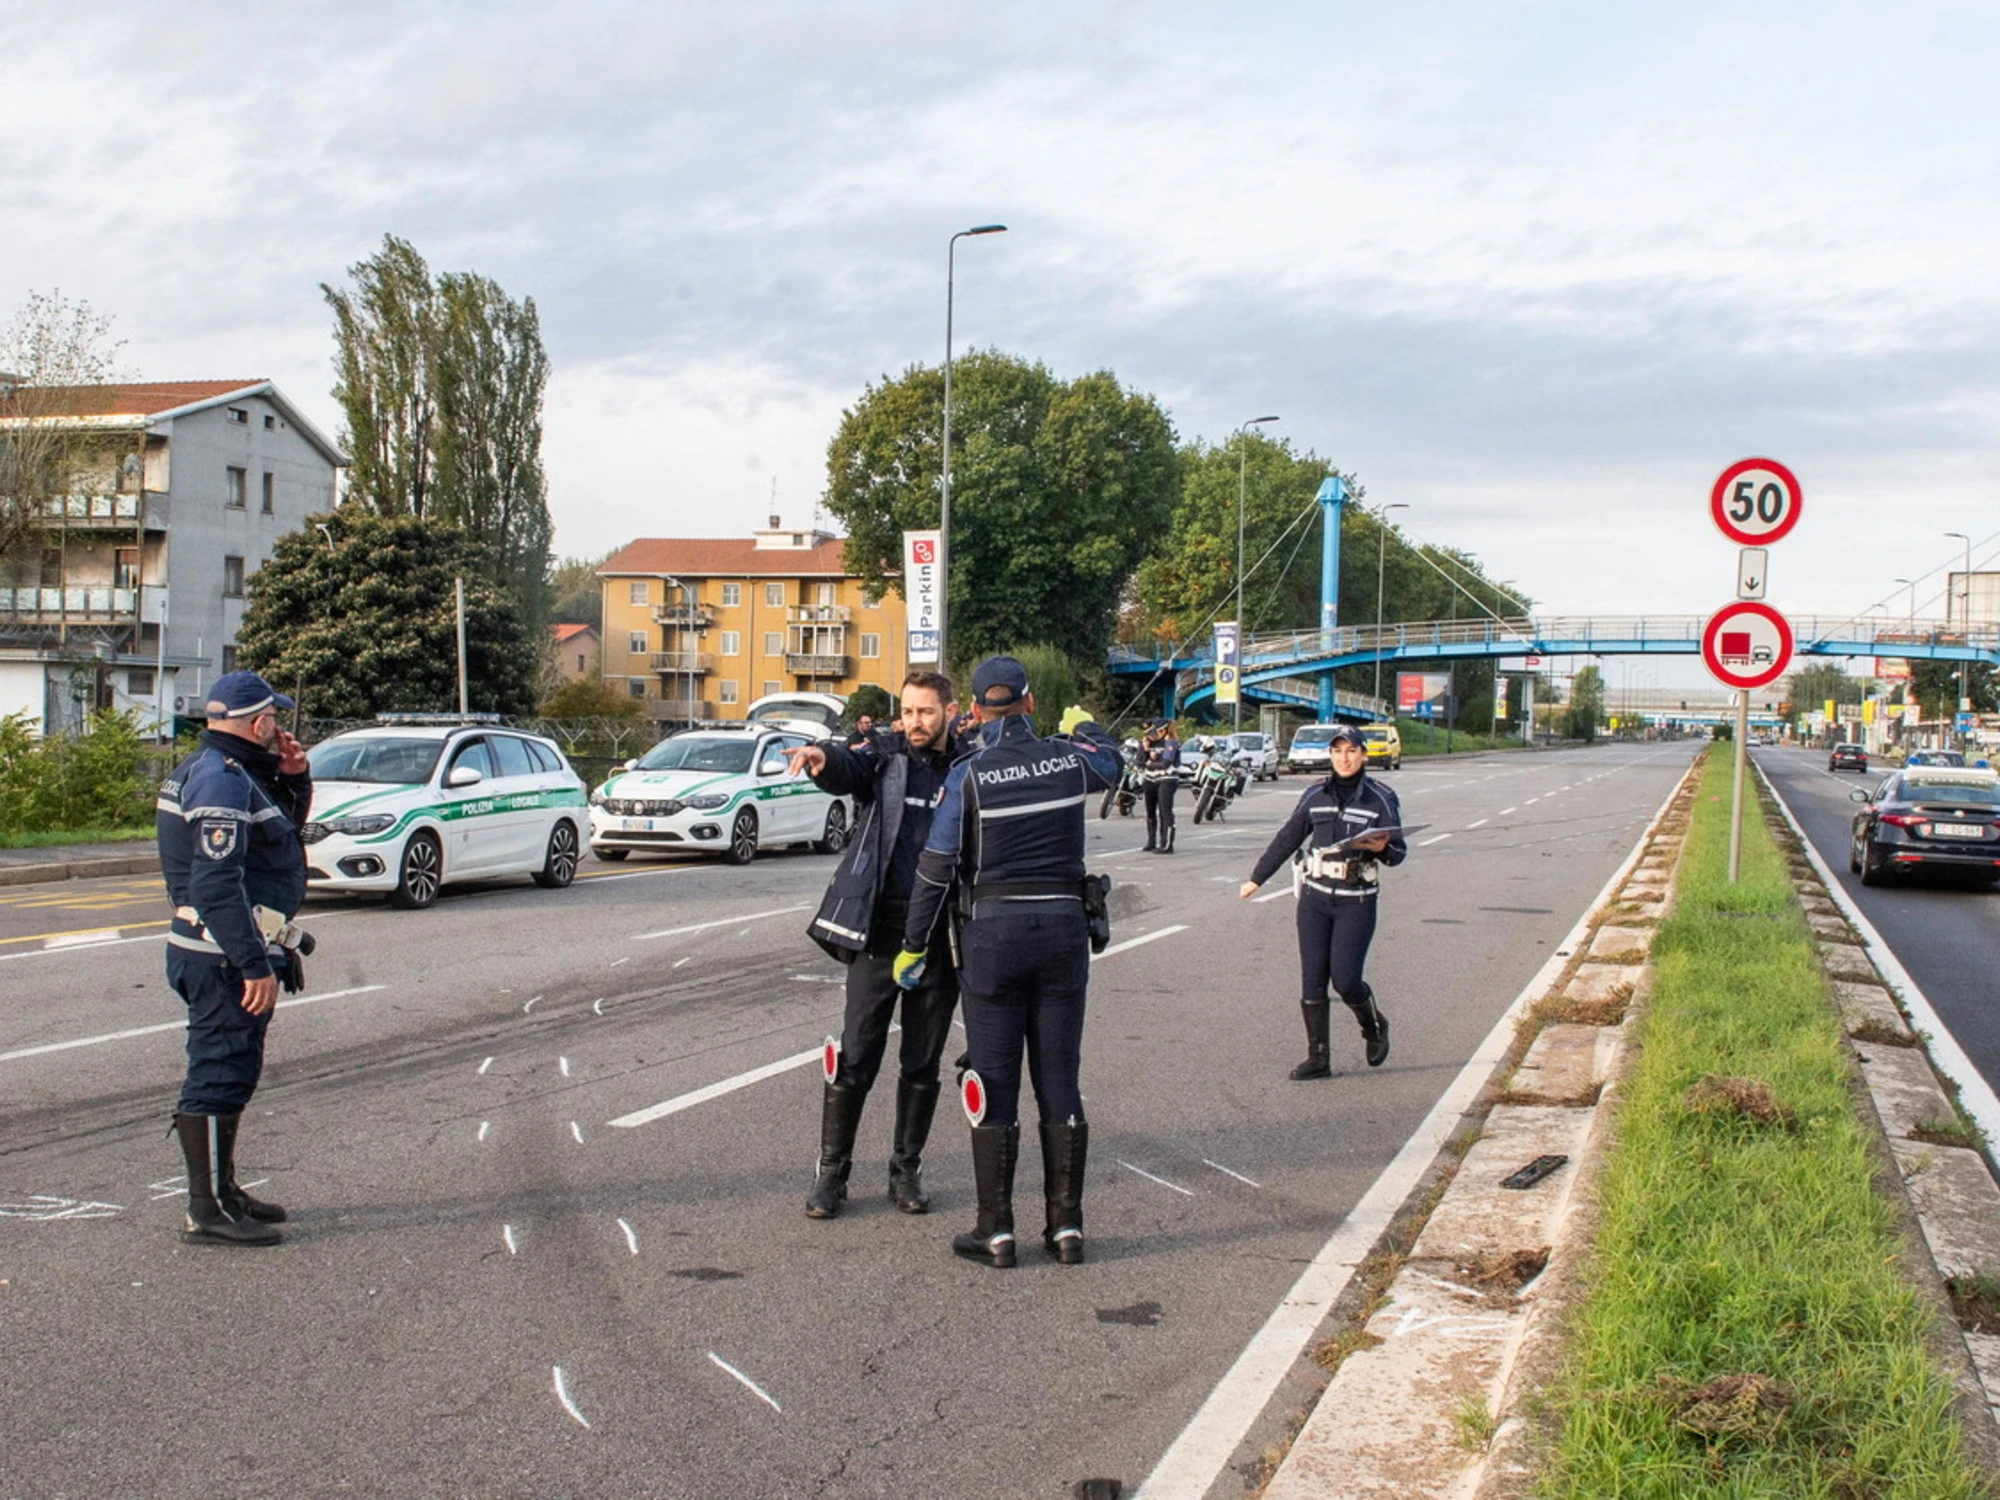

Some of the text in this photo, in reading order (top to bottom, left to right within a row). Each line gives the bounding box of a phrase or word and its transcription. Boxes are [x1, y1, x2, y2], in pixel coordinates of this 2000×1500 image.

[1729, 480, 1783, 524] 50
[977, 754, 1080, 786] POLIZIA LOCALE
